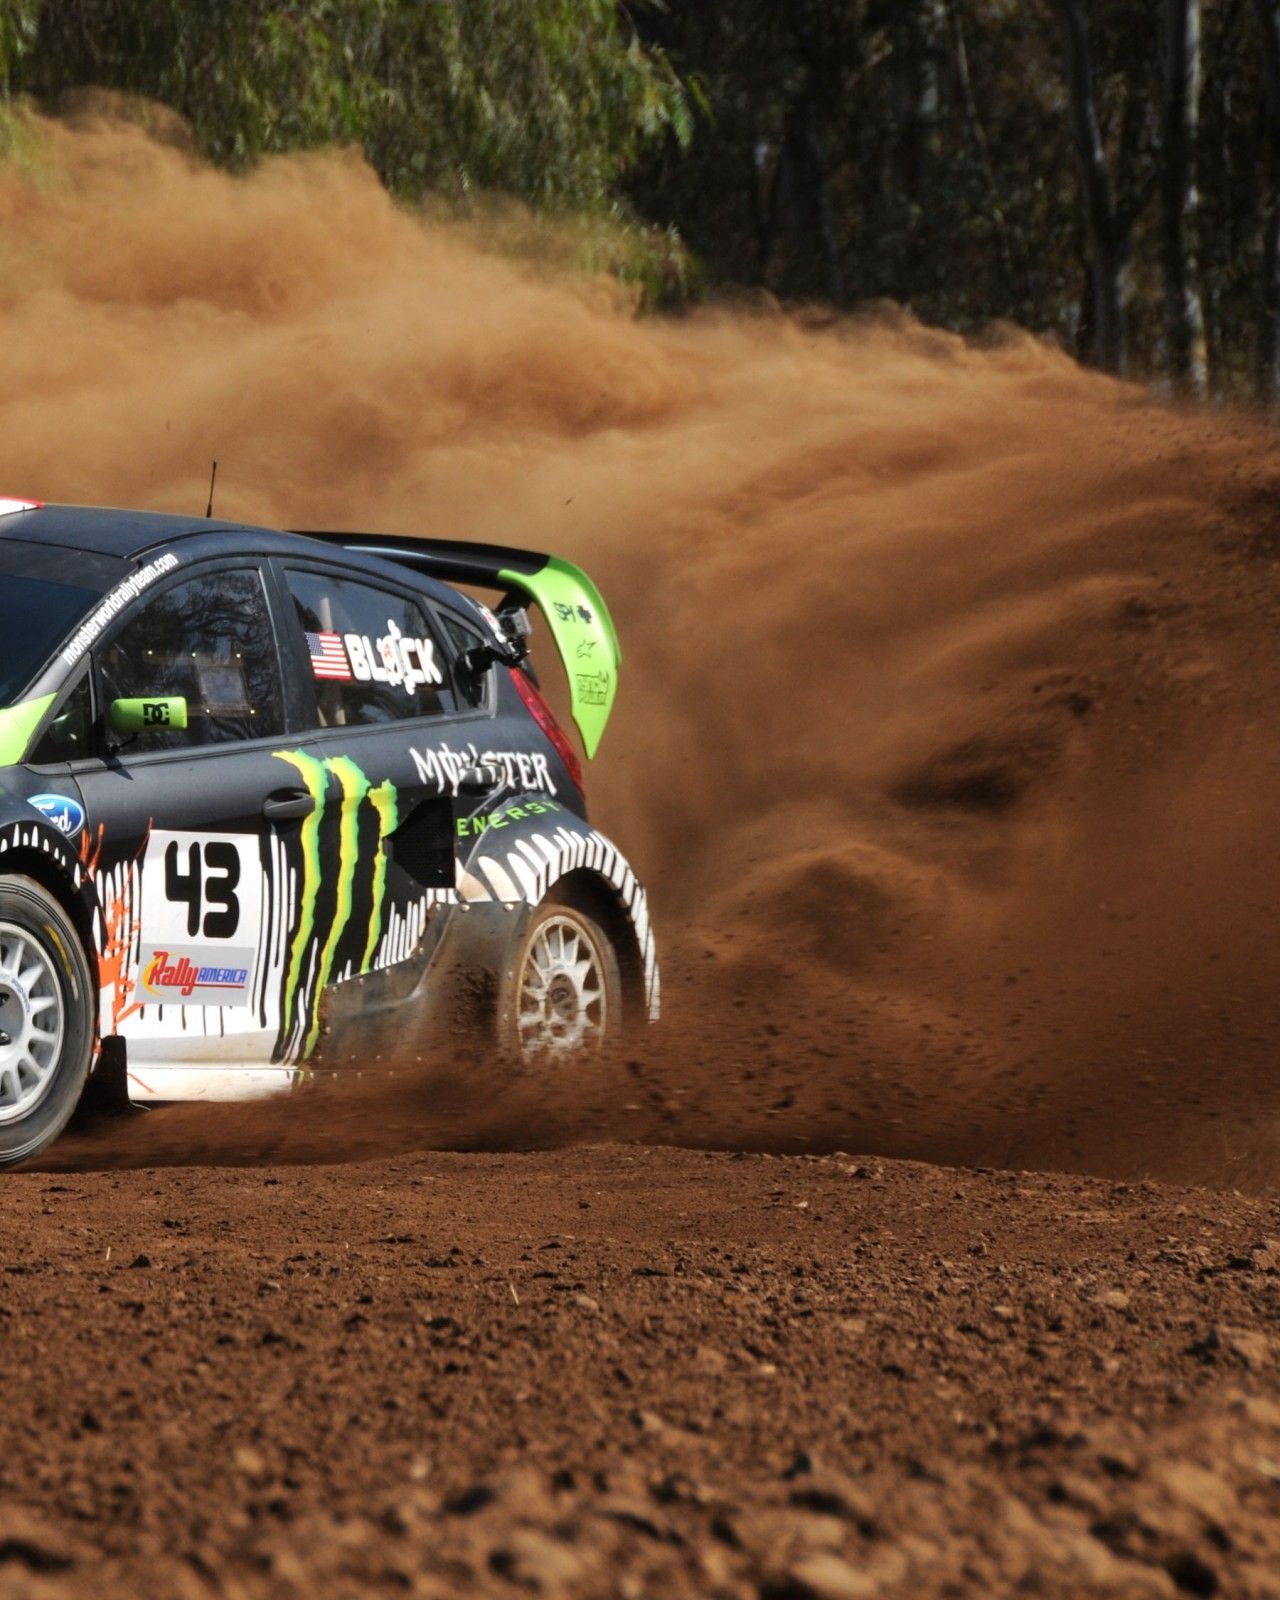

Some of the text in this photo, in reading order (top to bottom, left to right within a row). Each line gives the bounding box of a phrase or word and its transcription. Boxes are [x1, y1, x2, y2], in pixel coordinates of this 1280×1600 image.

[166, 839, 240, 938] 43
[148, 951, 248, 996] Rally AMERICA
